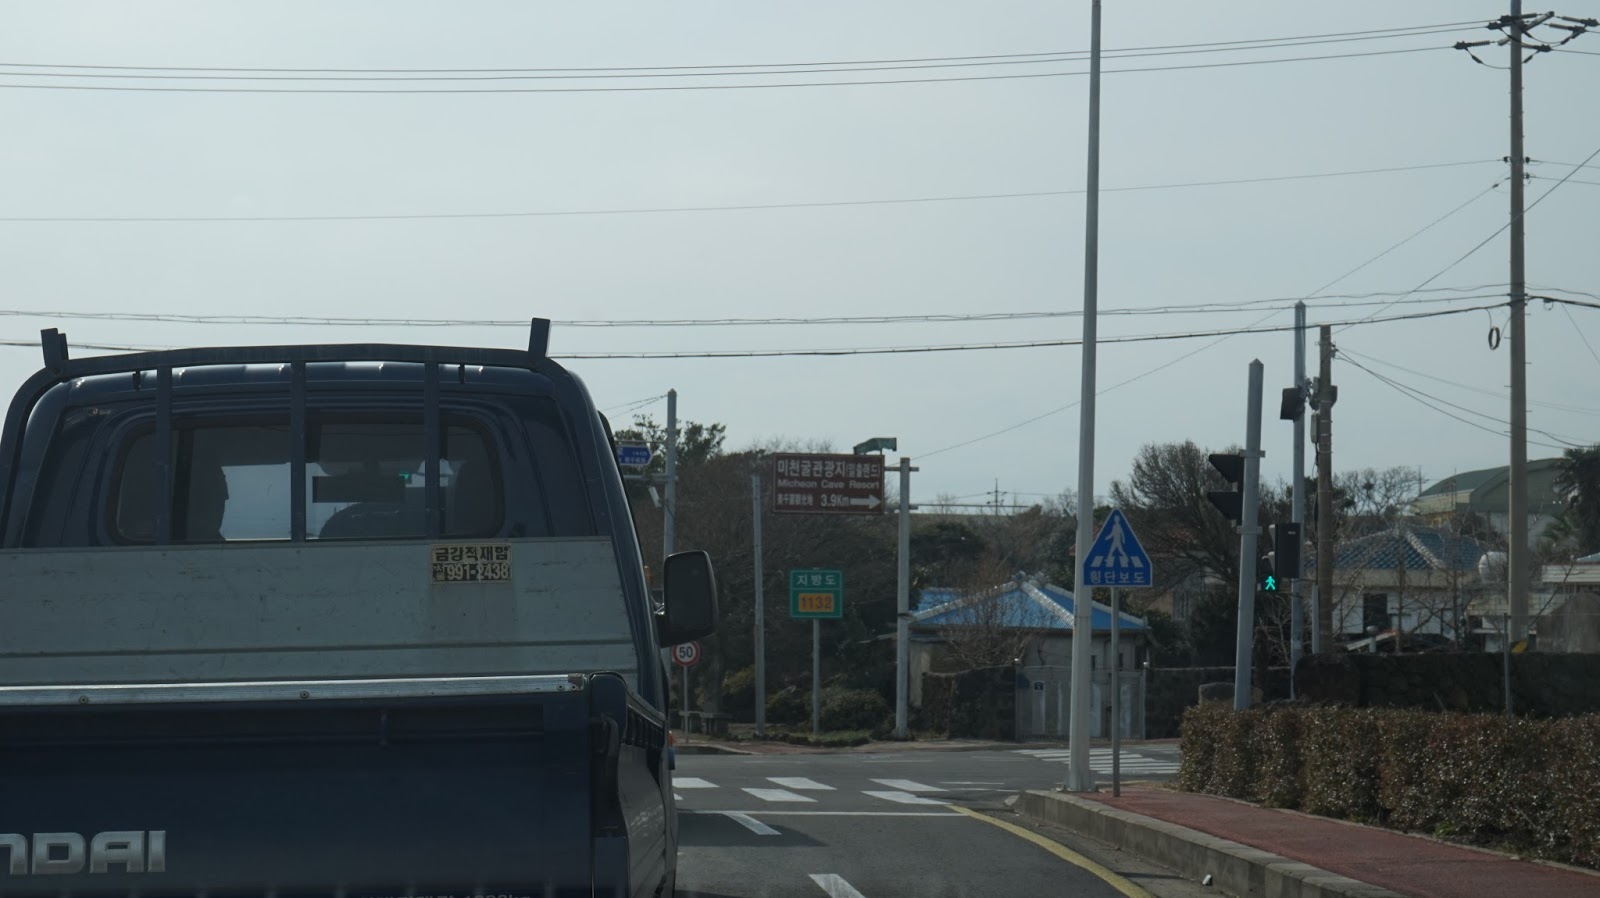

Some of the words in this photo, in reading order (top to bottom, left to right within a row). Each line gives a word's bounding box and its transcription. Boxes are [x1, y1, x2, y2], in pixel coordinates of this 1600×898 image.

[778, 479, 818, 488] Micheon
[821, 480, 844, 489] Cave
[849, 480, 880, 489] Resort
[820, 494, 850, 507] 3.9Km
[447, 563, 509, 580] 991-2438
[1090, 571, 1145, 584] 횡단보도
[797, 574, 836, 586] 지방도
[801, 596, 832, 609] 1132
[679, 646, 693, 659] 50
